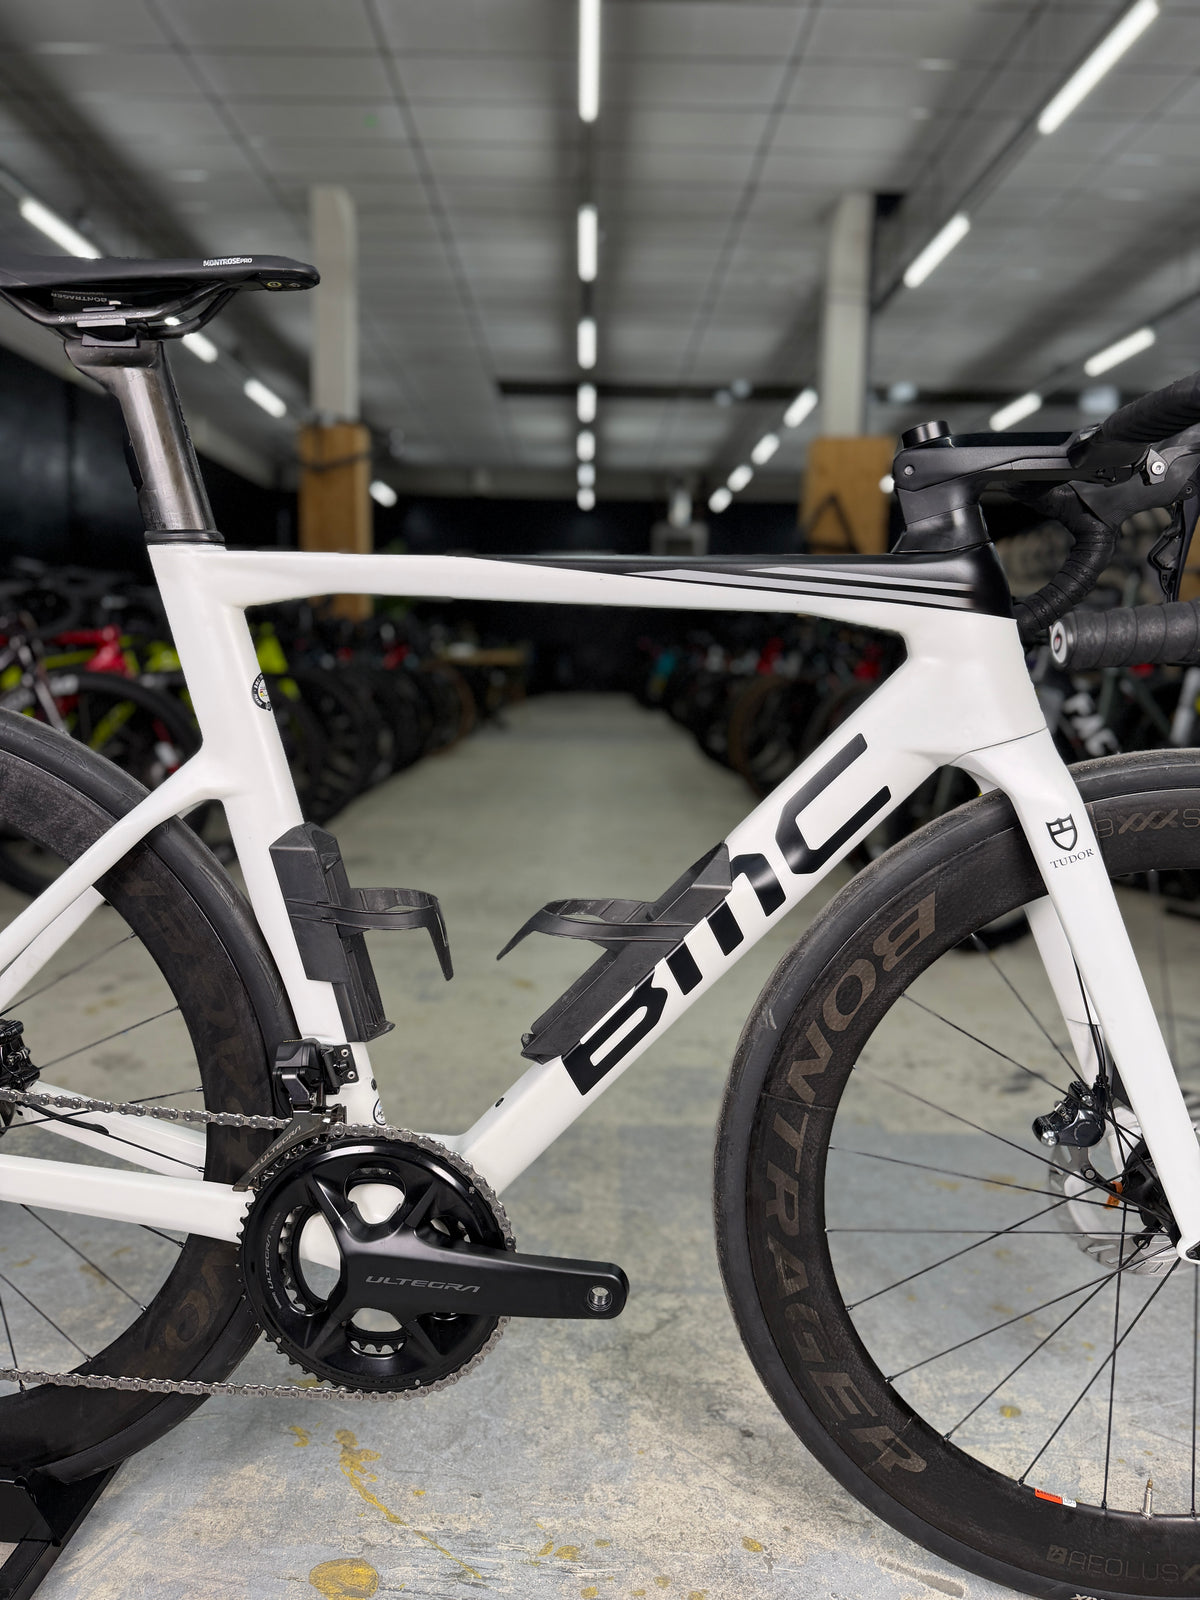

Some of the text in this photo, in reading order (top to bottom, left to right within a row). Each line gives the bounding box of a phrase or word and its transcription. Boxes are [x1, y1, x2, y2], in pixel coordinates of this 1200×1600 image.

[1050, 848, 1095, 869] TUDOR
[260, 1124, 301, 1163] ULTEGRA
[765, 891, 936, 1473] BONTRAGER
[264, 1233, 275, 1290] ULTEGRA
[365, 1275, 481, 1293] ULTEGRA
[1067, 1550, 1180, 1583] AEOLUS
